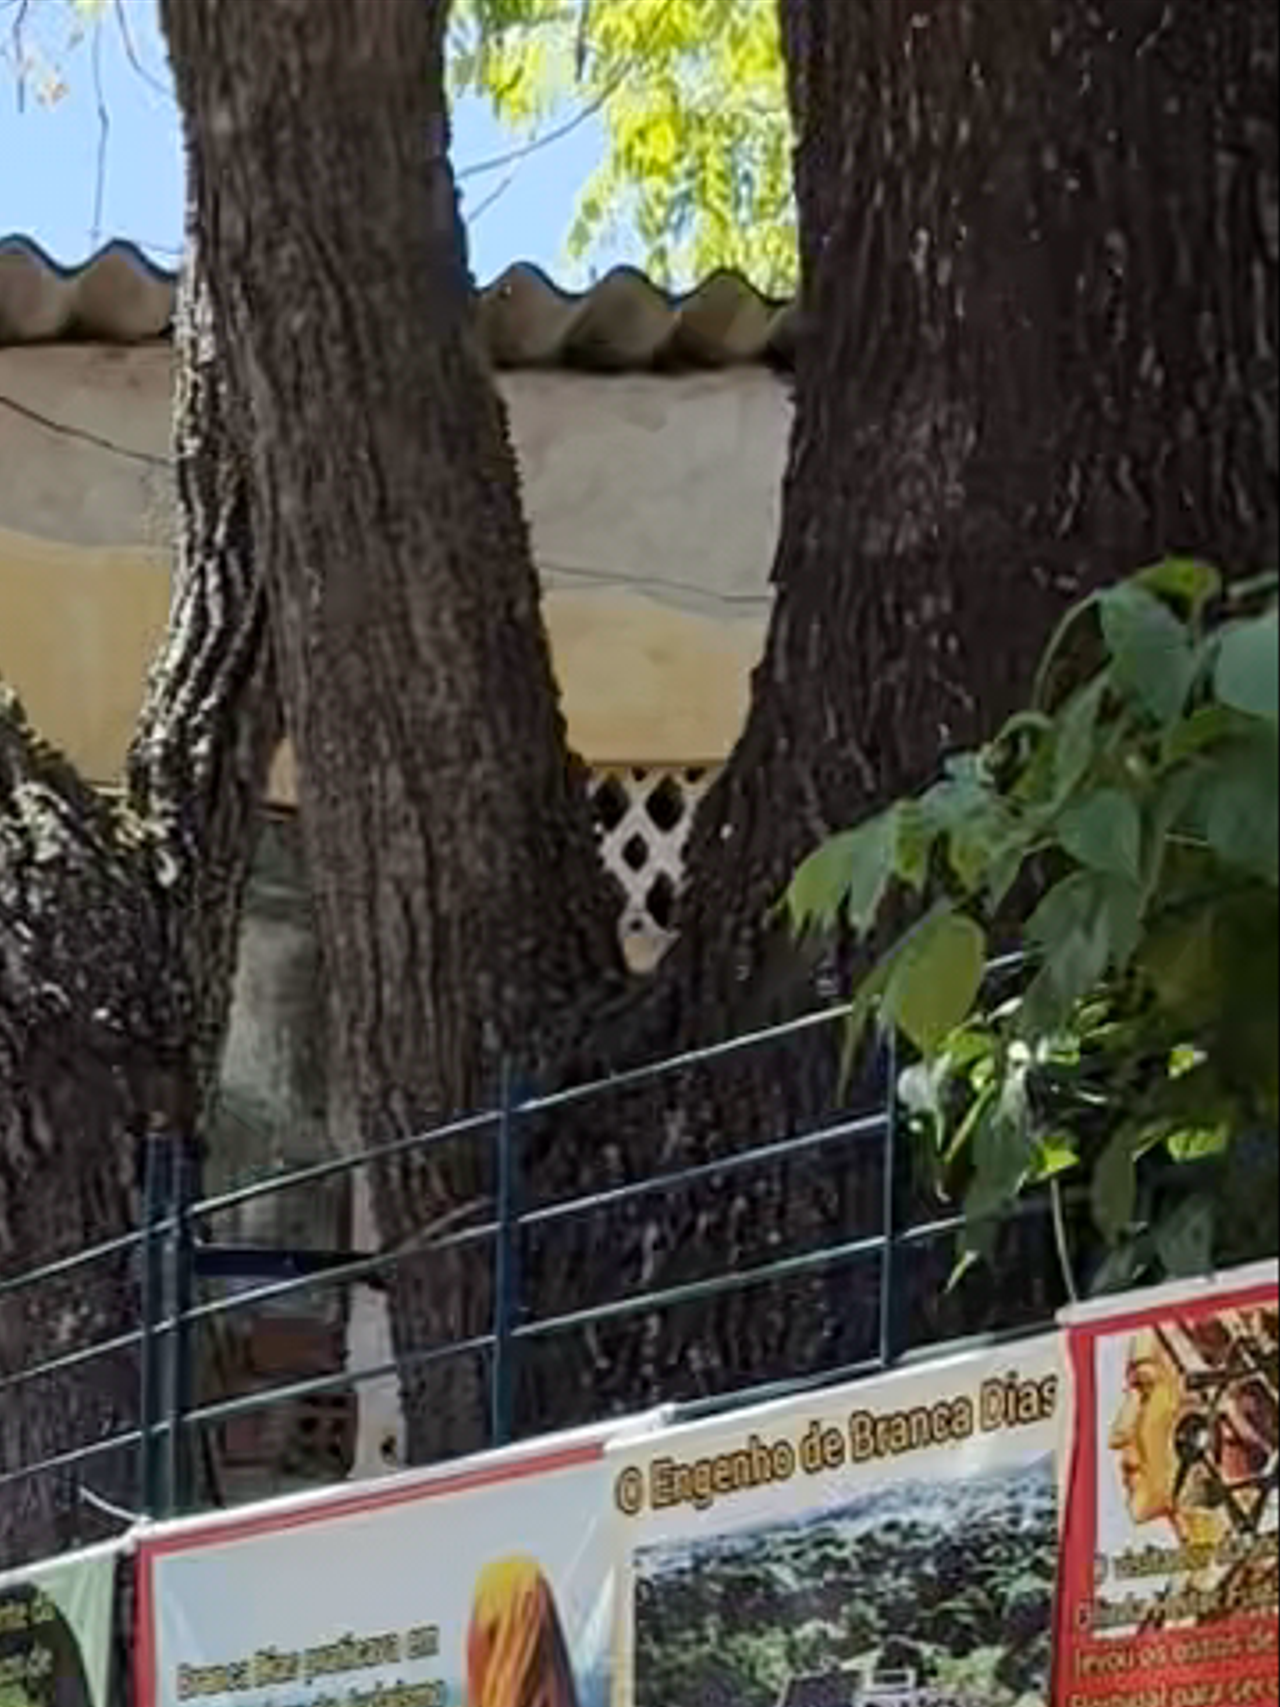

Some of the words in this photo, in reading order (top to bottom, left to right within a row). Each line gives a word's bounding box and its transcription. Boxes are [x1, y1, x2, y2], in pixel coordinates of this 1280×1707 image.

[615, 1467, 641, 1514] O
[650, 1435, 794, 1511] Engenho
[801, 1420, 844, 1472] de
[849, 1396, 973, 1462] Branca
[980, 1370, 1058, 1431] Dias
